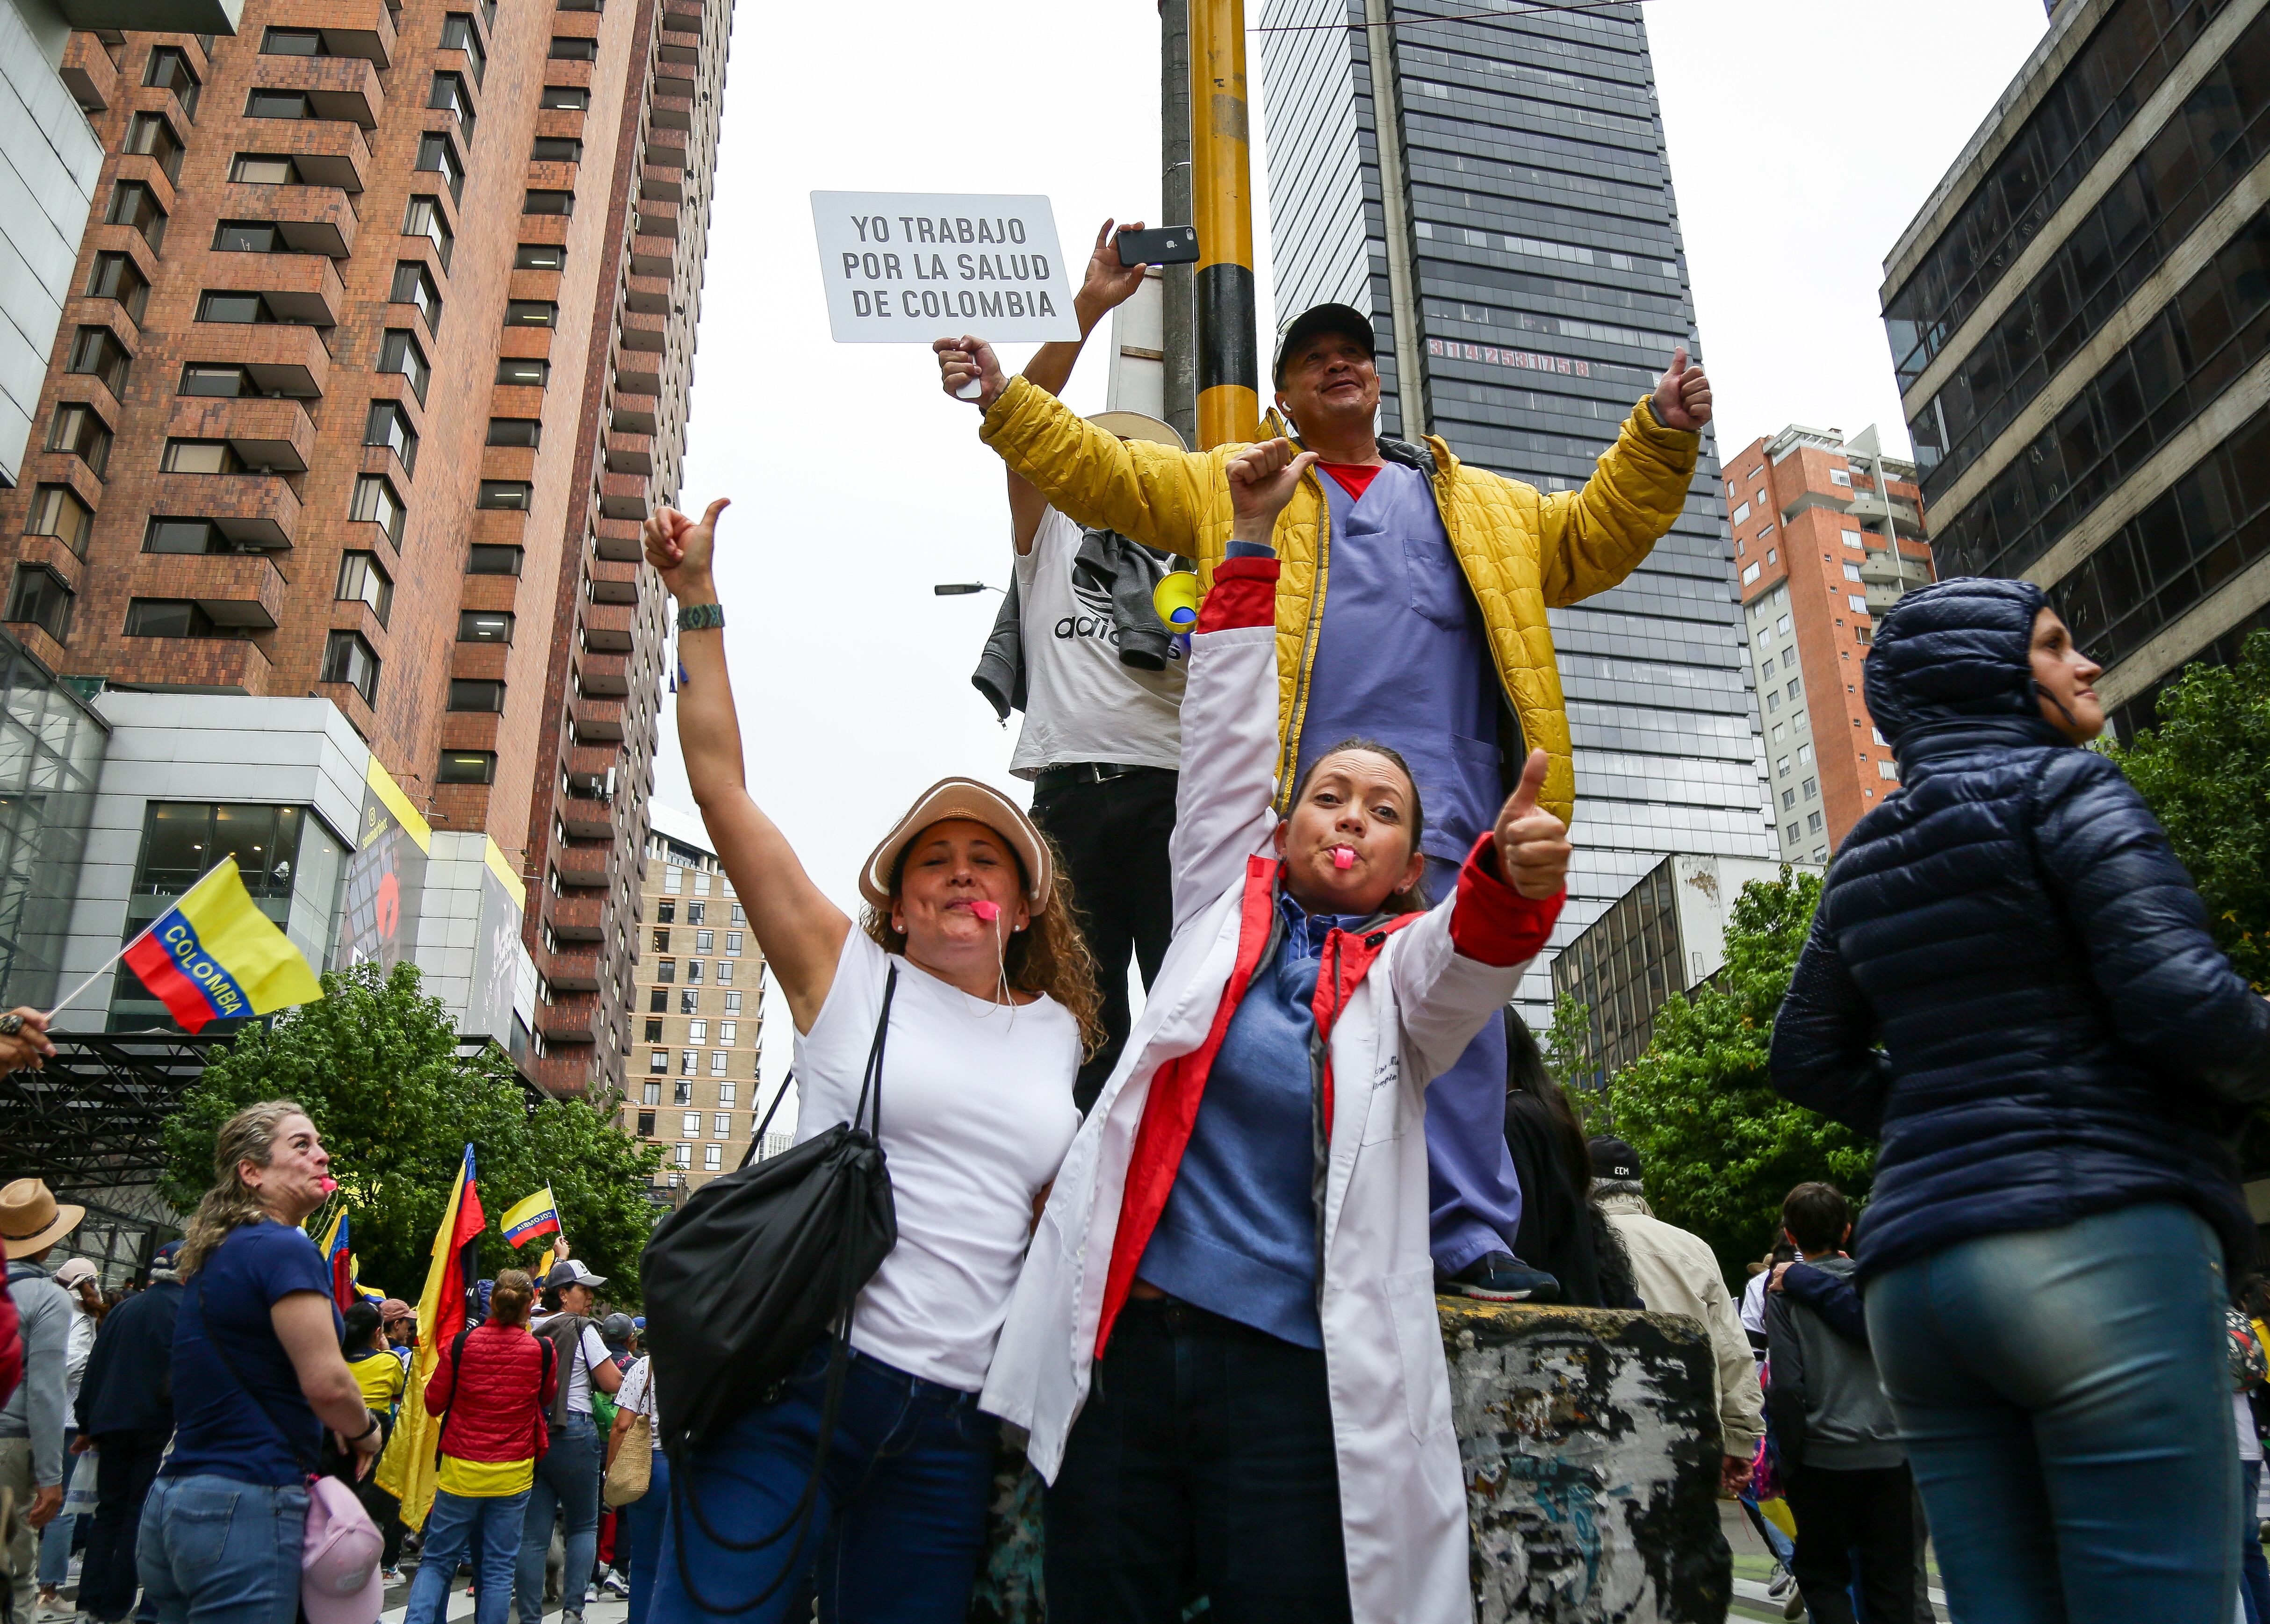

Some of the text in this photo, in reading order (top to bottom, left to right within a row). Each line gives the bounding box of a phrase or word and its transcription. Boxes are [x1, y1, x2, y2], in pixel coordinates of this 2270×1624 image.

[850, 215, 1027, 245] YO TRABAJO
[842, 252, 1051, 281] POR LA SALUD
[852, 289, 1057, 318] DE COLOMBIA
